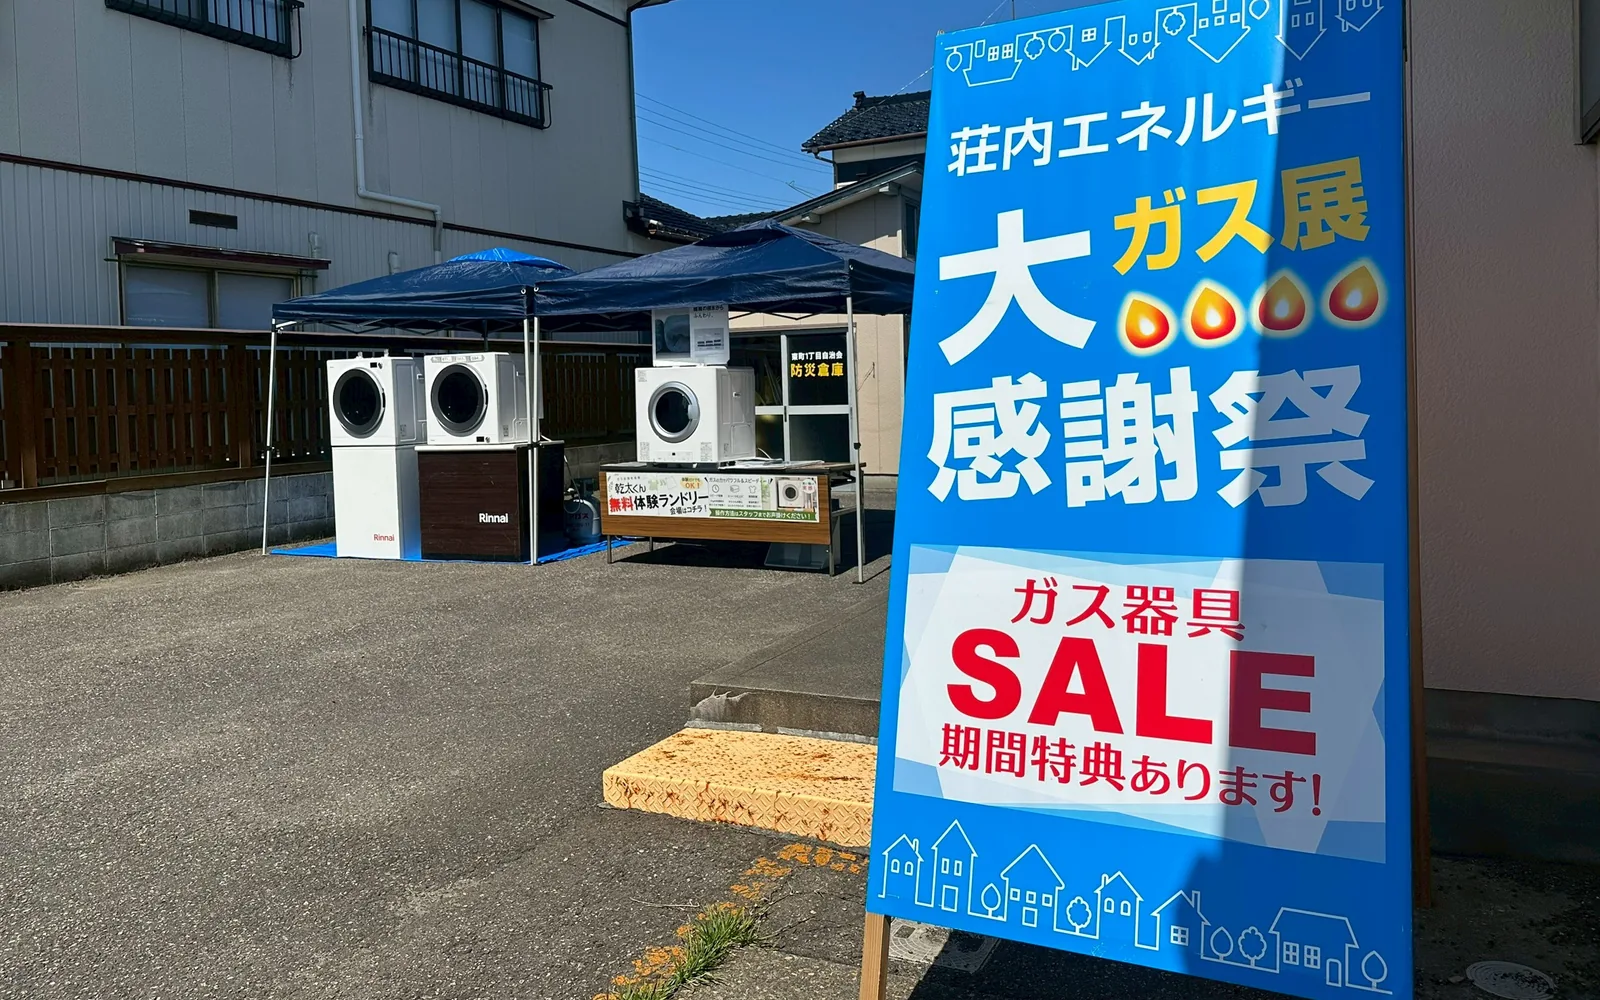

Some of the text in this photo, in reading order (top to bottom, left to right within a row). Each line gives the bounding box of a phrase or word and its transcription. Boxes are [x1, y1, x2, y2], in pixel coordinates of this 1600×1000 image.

[947, 78, 1371, 176] 荘内エネルギー
[1113, 156, 1371, 275] ガス展
[938, 209, 1097, 365] 大
[790, 362, 844, 377] 防災倉庫
[927, 365, 1375, 508] 感謝祭
[479, 513, 509, 524] Rinnai
[609, 491, 709, 512] 無料体験ランドリー
[615, 482, 646, 494] 乾太くん
[373, 533, 395, 542] Rinnai
[1011, 577, 1245, 641] ガス器具
[946, 628, 1317, 756] SALE
[939, 723, 1322, 816] 期間特典あります!
